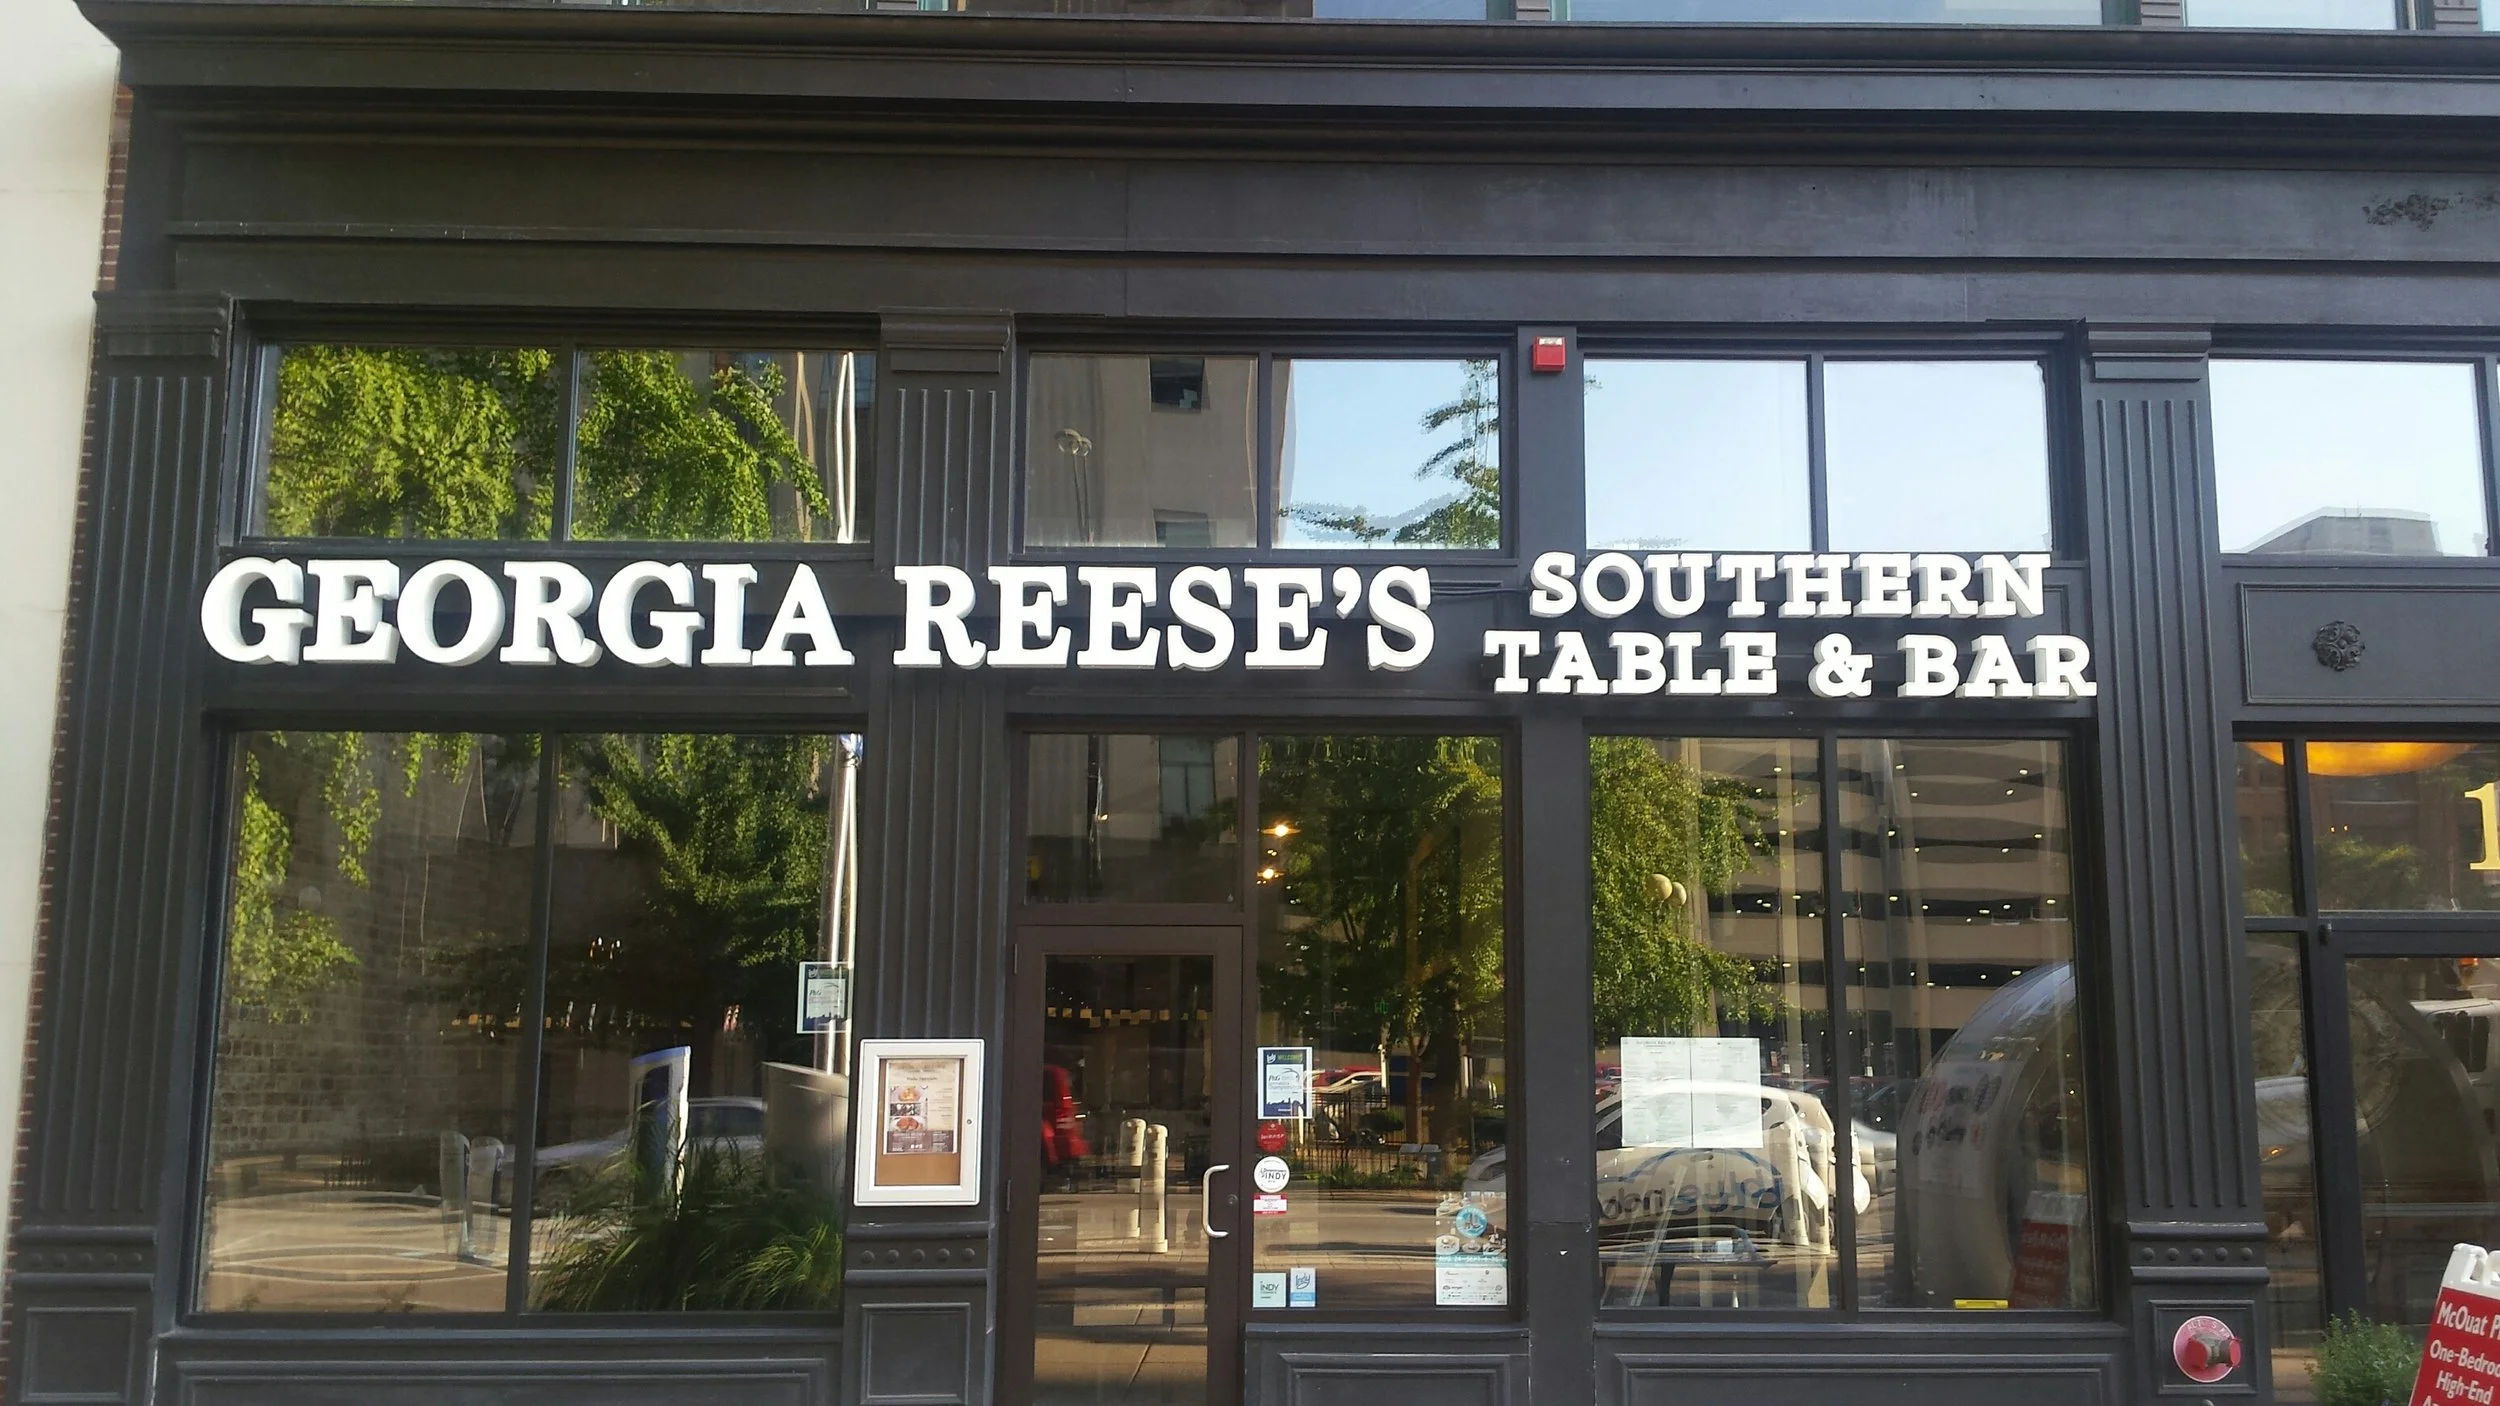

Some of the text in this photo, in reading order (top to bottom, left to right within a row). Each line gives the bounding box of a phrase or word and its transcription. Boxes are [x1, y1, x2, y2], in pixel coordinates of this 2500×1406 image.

[201, 557, 1435, 672] GEORGIA REESE'S
[1530, 552, 2051, 619] SOUTHERN
[1483, 630, 2099, 699] TABLE & BAR
[2464, 782, 2500, 870] 1
[2436, 1301, 2500, 1341] McOuat P
[2435, 1370, 2494, 1405] High-End
